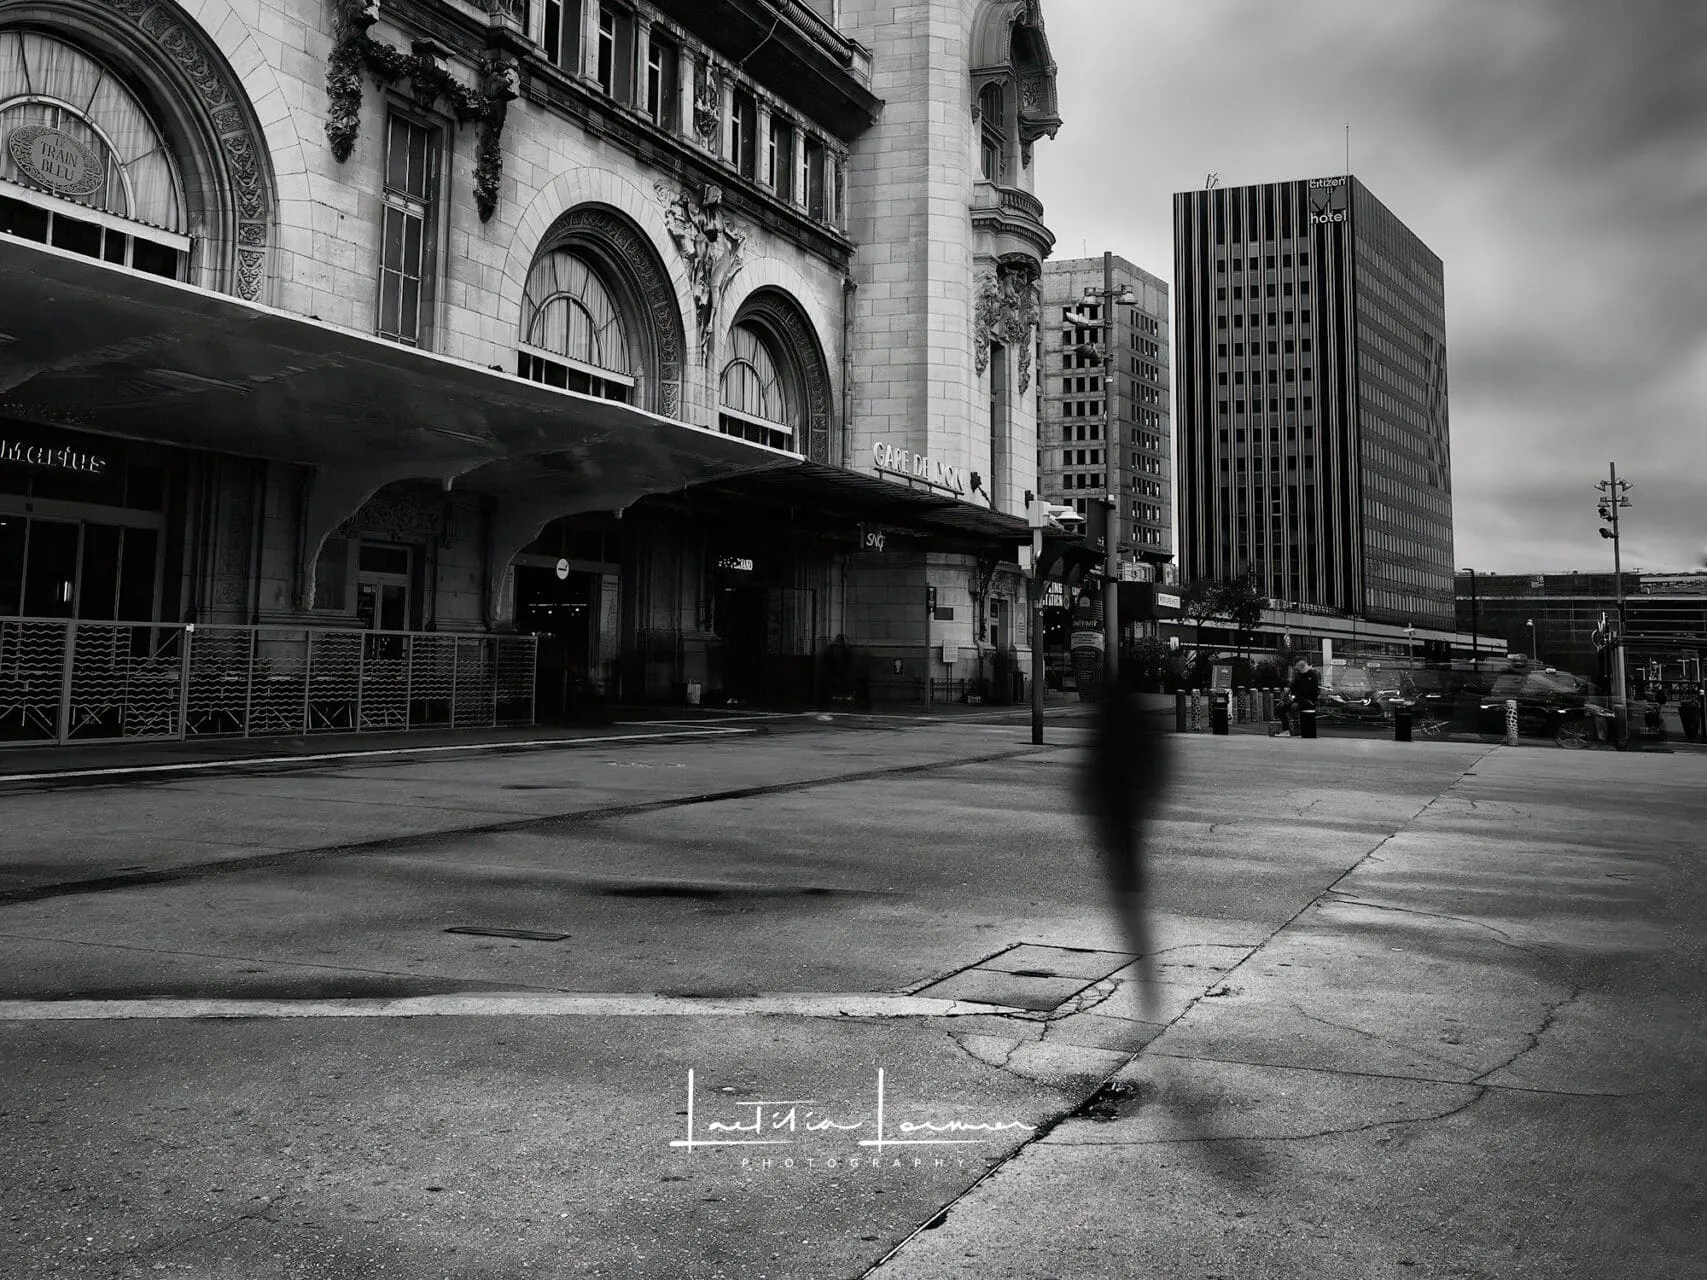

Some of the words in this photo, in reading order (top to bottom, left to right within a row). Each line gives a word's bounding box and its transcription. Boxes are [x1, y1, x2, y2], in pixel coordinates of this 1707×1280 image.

[40, 141, 78, 167] TRAIN
[41, 158, 74, 181] BLEU
[1309, 178, 1346, 189] citizen
[1310, 210, 1347, 224] hotel
[873, 442, 910, 474] GARE
[913, 453, 928, 481] DE
